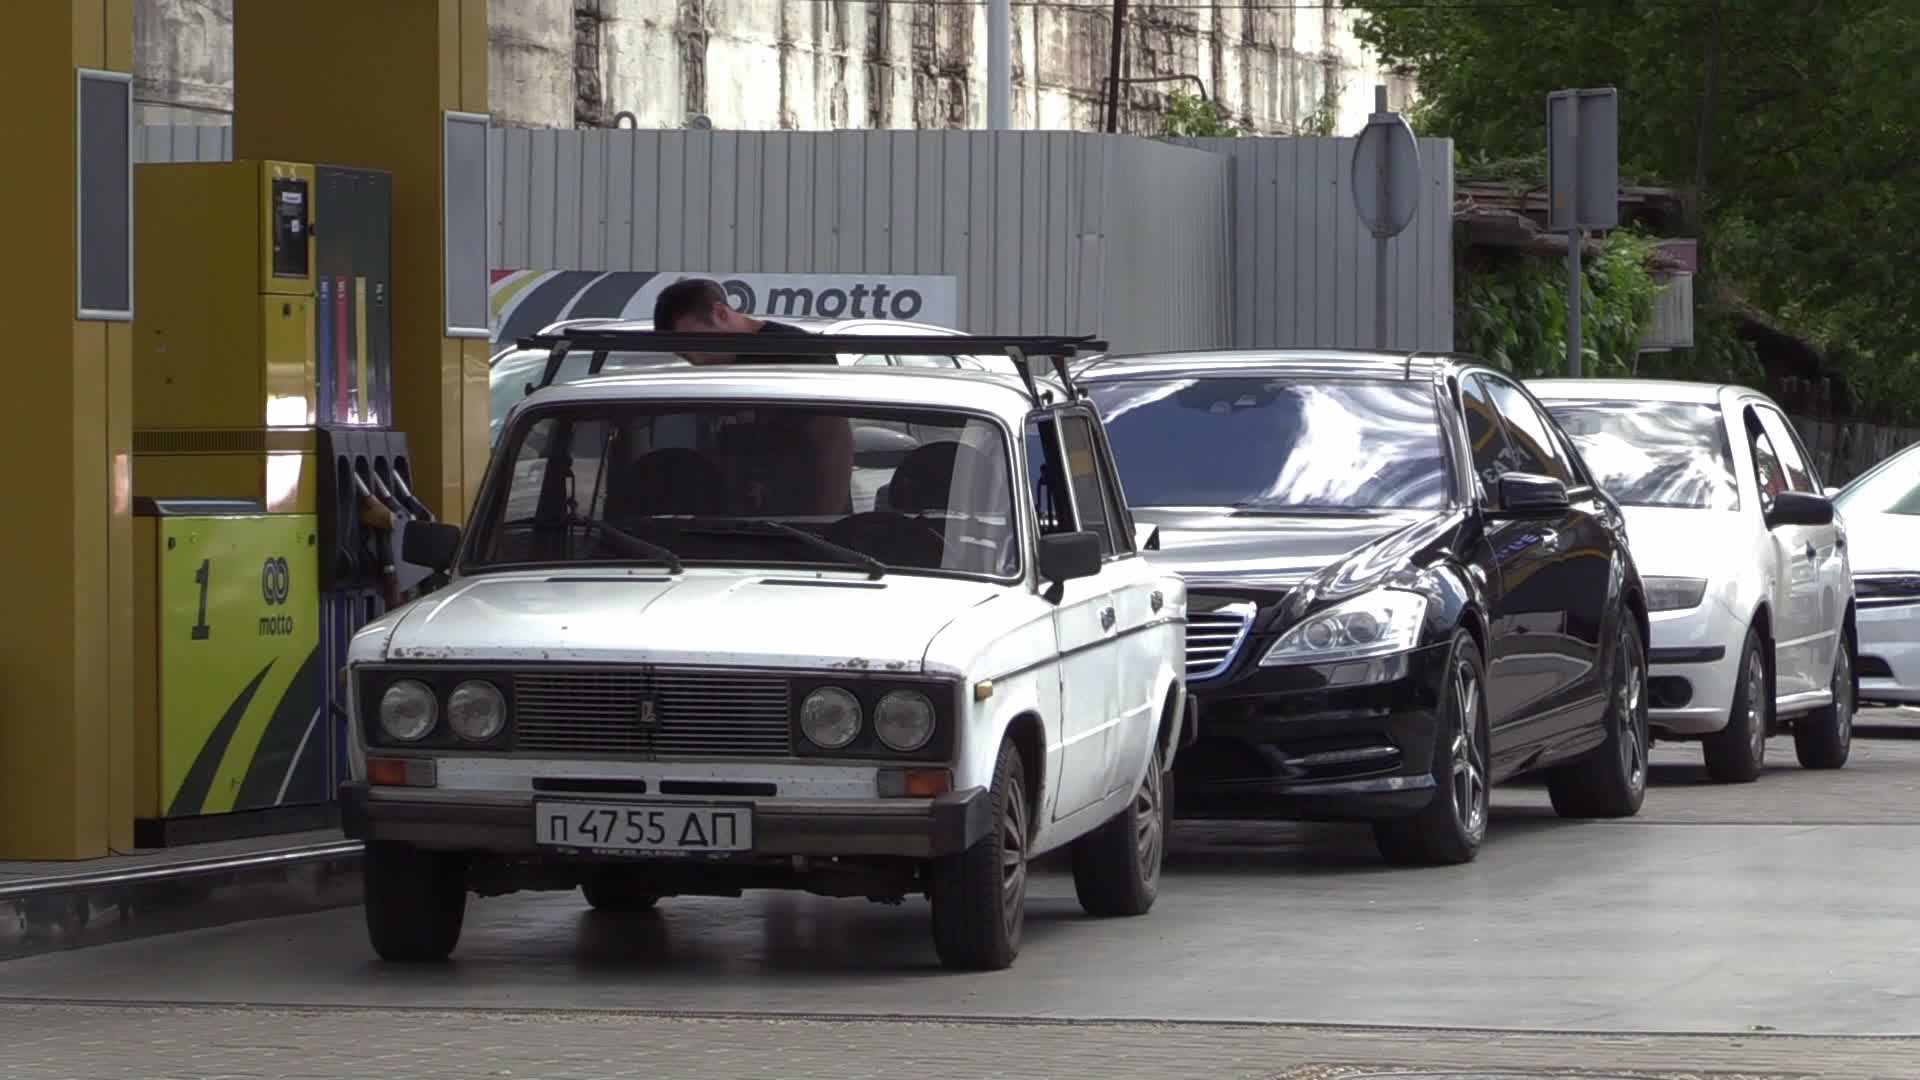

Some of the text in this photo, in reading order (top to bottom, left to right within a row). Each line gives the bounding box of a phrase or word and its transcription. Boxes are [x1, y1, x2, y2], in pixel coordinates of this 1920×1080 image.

[766, 282, 922, 320] motto
[191, 559, 211, 640] 1
[258, 614, 294, 637] motto
[578, 809, 666, 844] 4755
